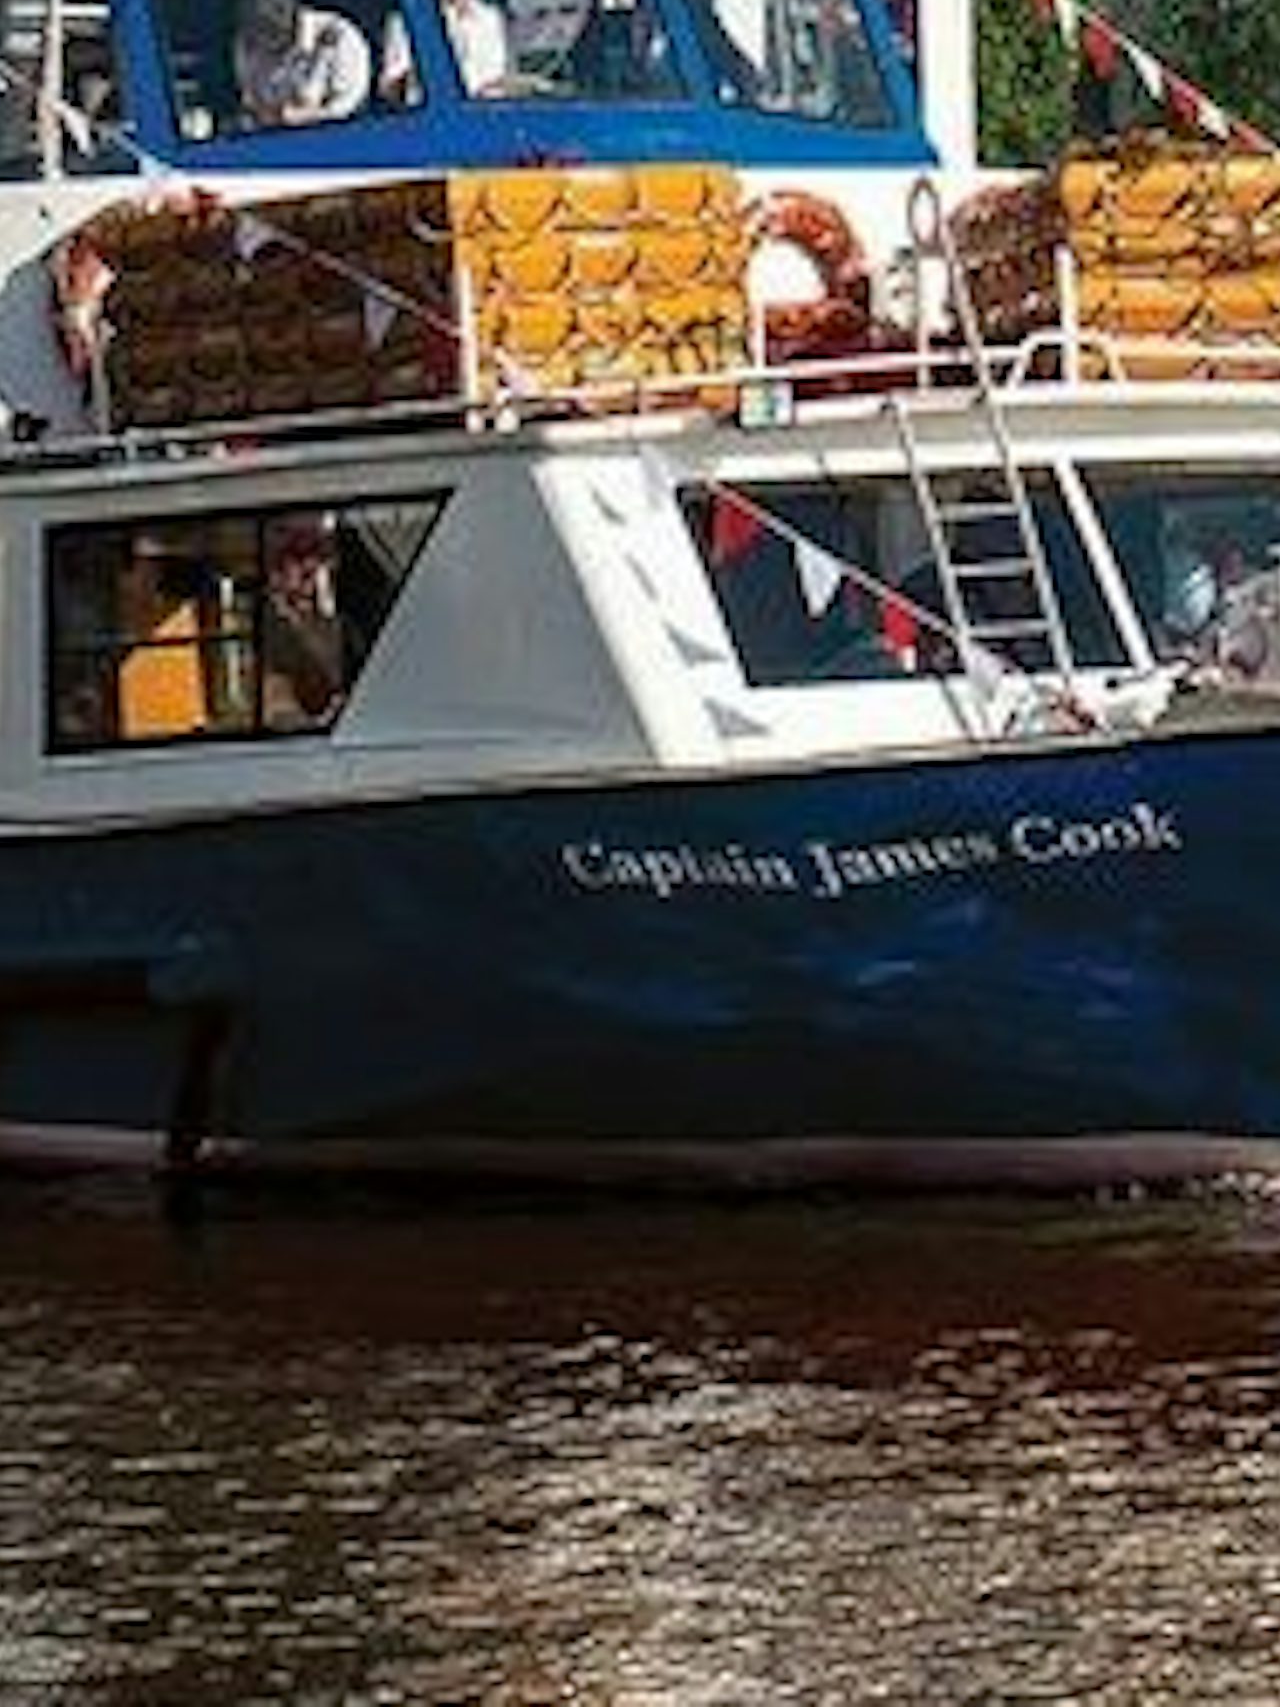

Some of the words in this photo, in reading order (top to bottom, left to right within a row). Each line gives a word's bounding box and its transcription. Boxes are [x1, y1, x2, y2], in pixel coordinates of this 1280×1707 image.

[562, 842, 798, 897] Captain
[809, 829, 1000, 897] James
[1011, 801, 1184, 863] Cook
